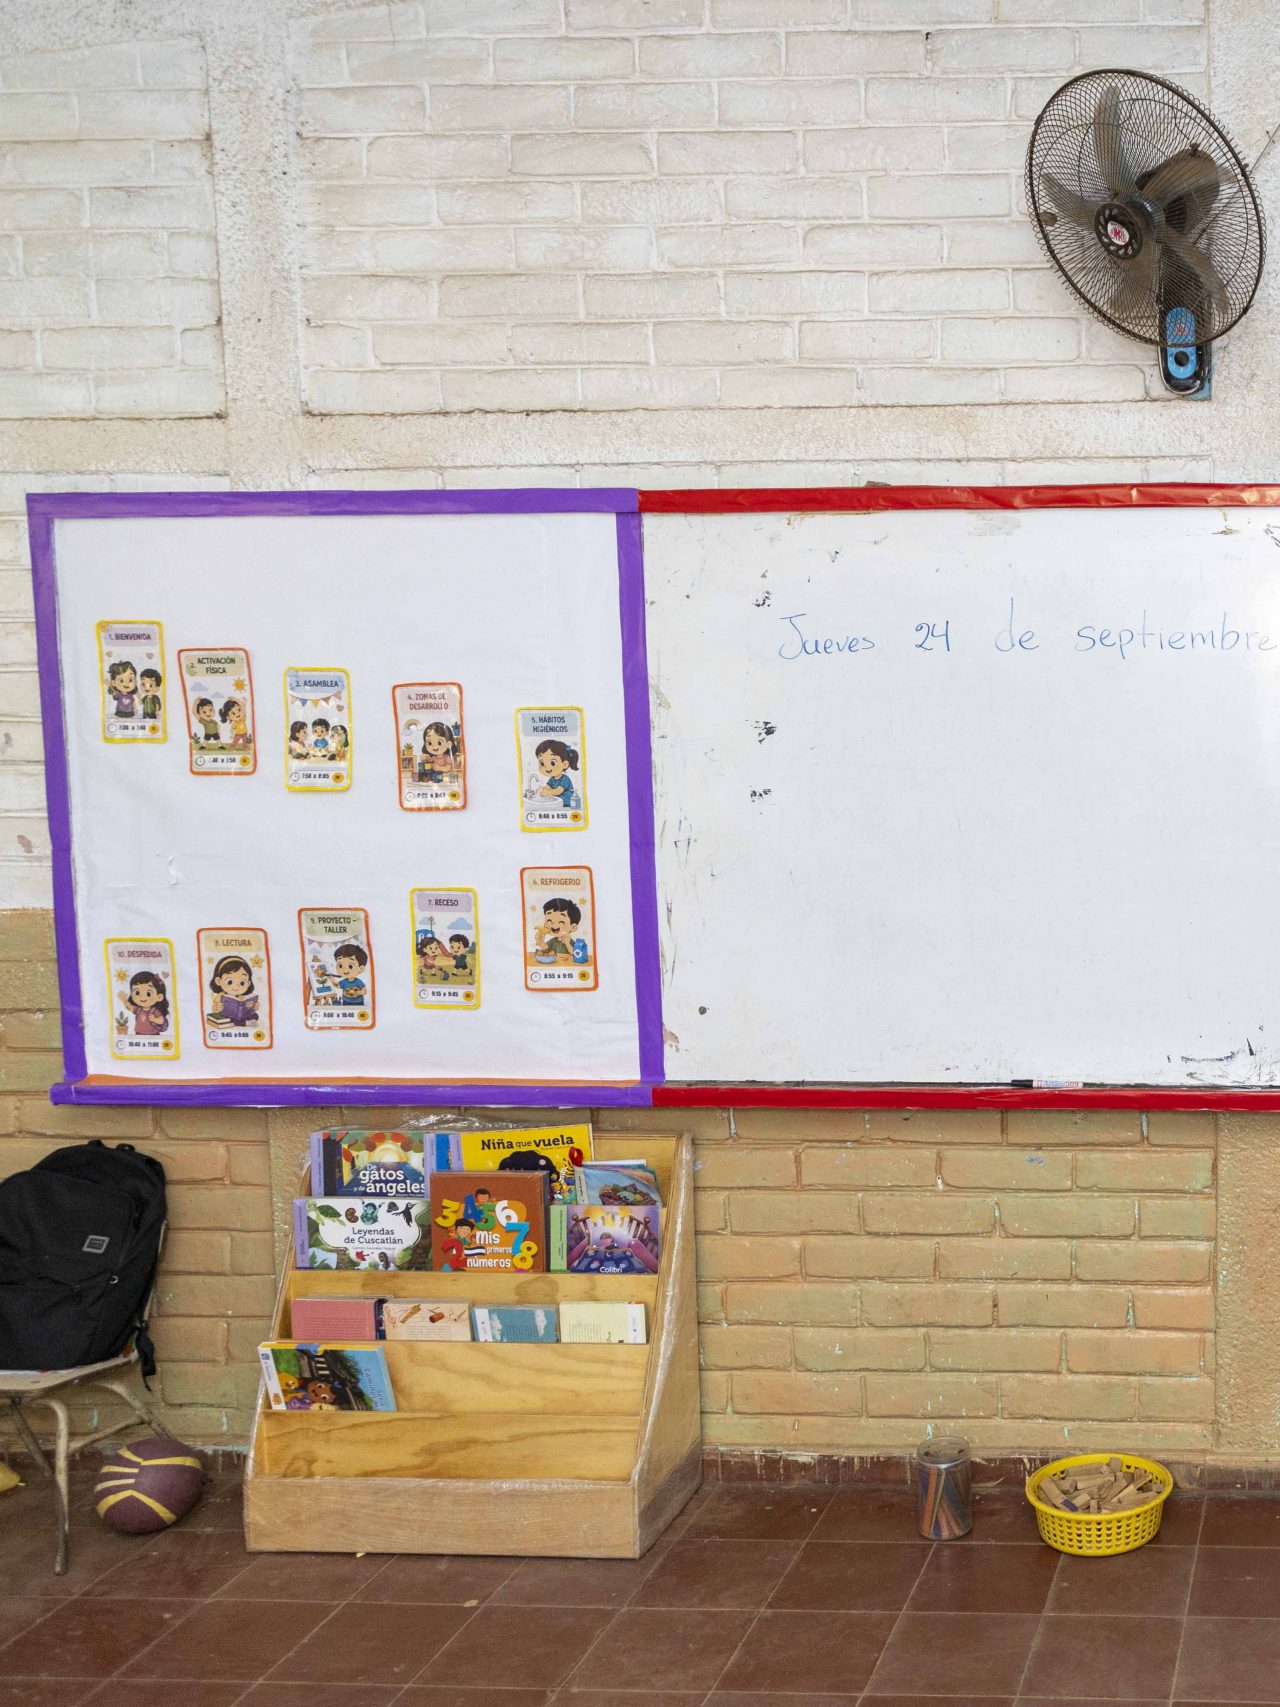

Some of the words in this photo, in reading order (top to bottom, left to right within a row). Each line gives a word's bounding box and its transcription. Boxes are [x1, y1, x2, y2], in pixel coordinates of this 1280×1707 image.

[778, 613, 875, 659] Jueves
[914, 619, 951, 652] 24
[994, 596, 1040, 652] de
[1074, 613, 1278, 660] septiembre
[115, 633, 152, 641] BIENVENIDA
[197, 656, 236, 665] ACTIVACIÓN
[206, 666, 227, 674] FÍSICA
[303, 680, 339, 688] ASAMBLEA
[409, 703, 449, 711] DESARROLLO
[538, 715, 566, 724] HÁBITOS
[532, 724, 568, 733] HIGIÉNICOS
[540, 878, 581, 886] REFRIGERIO
[434, 898, 459, 907] RECESO
[318, 916, 351, 924] PROYECTO
[324, 926, 348, 934] TALLER
[222, 939, 252, 947] LECTURA
[127, 950, 162, 958] DESPEDIDA
[481, 1139, 514, 1150] Niña
[516, 1140, 532, 1148] que
[533, 1134, 575, 1148] vuela
[366, 1163, 377, 1171] De
[360, 1167, 405, 1184] gatos
[434, 1198, 460, 1228] 3
[463, 1193, 483, 1222] 4
[475, 1203, 496, 1231] 5
[495, 1200, 519, 1228] 6
[352, 1227, 395, 1237] Leyendas
[344, 1236, 355, 1244] de
[357, 1236, 404, 1245] Cuscatlán
[475, 1230, 500, 1244] Mis
[505, 1221, 530, 1256] 7
[441, 1238, 467, 1268] 2
[512, 1241, 538, 1270] 8
[467, 1256, 511, 1268] números
